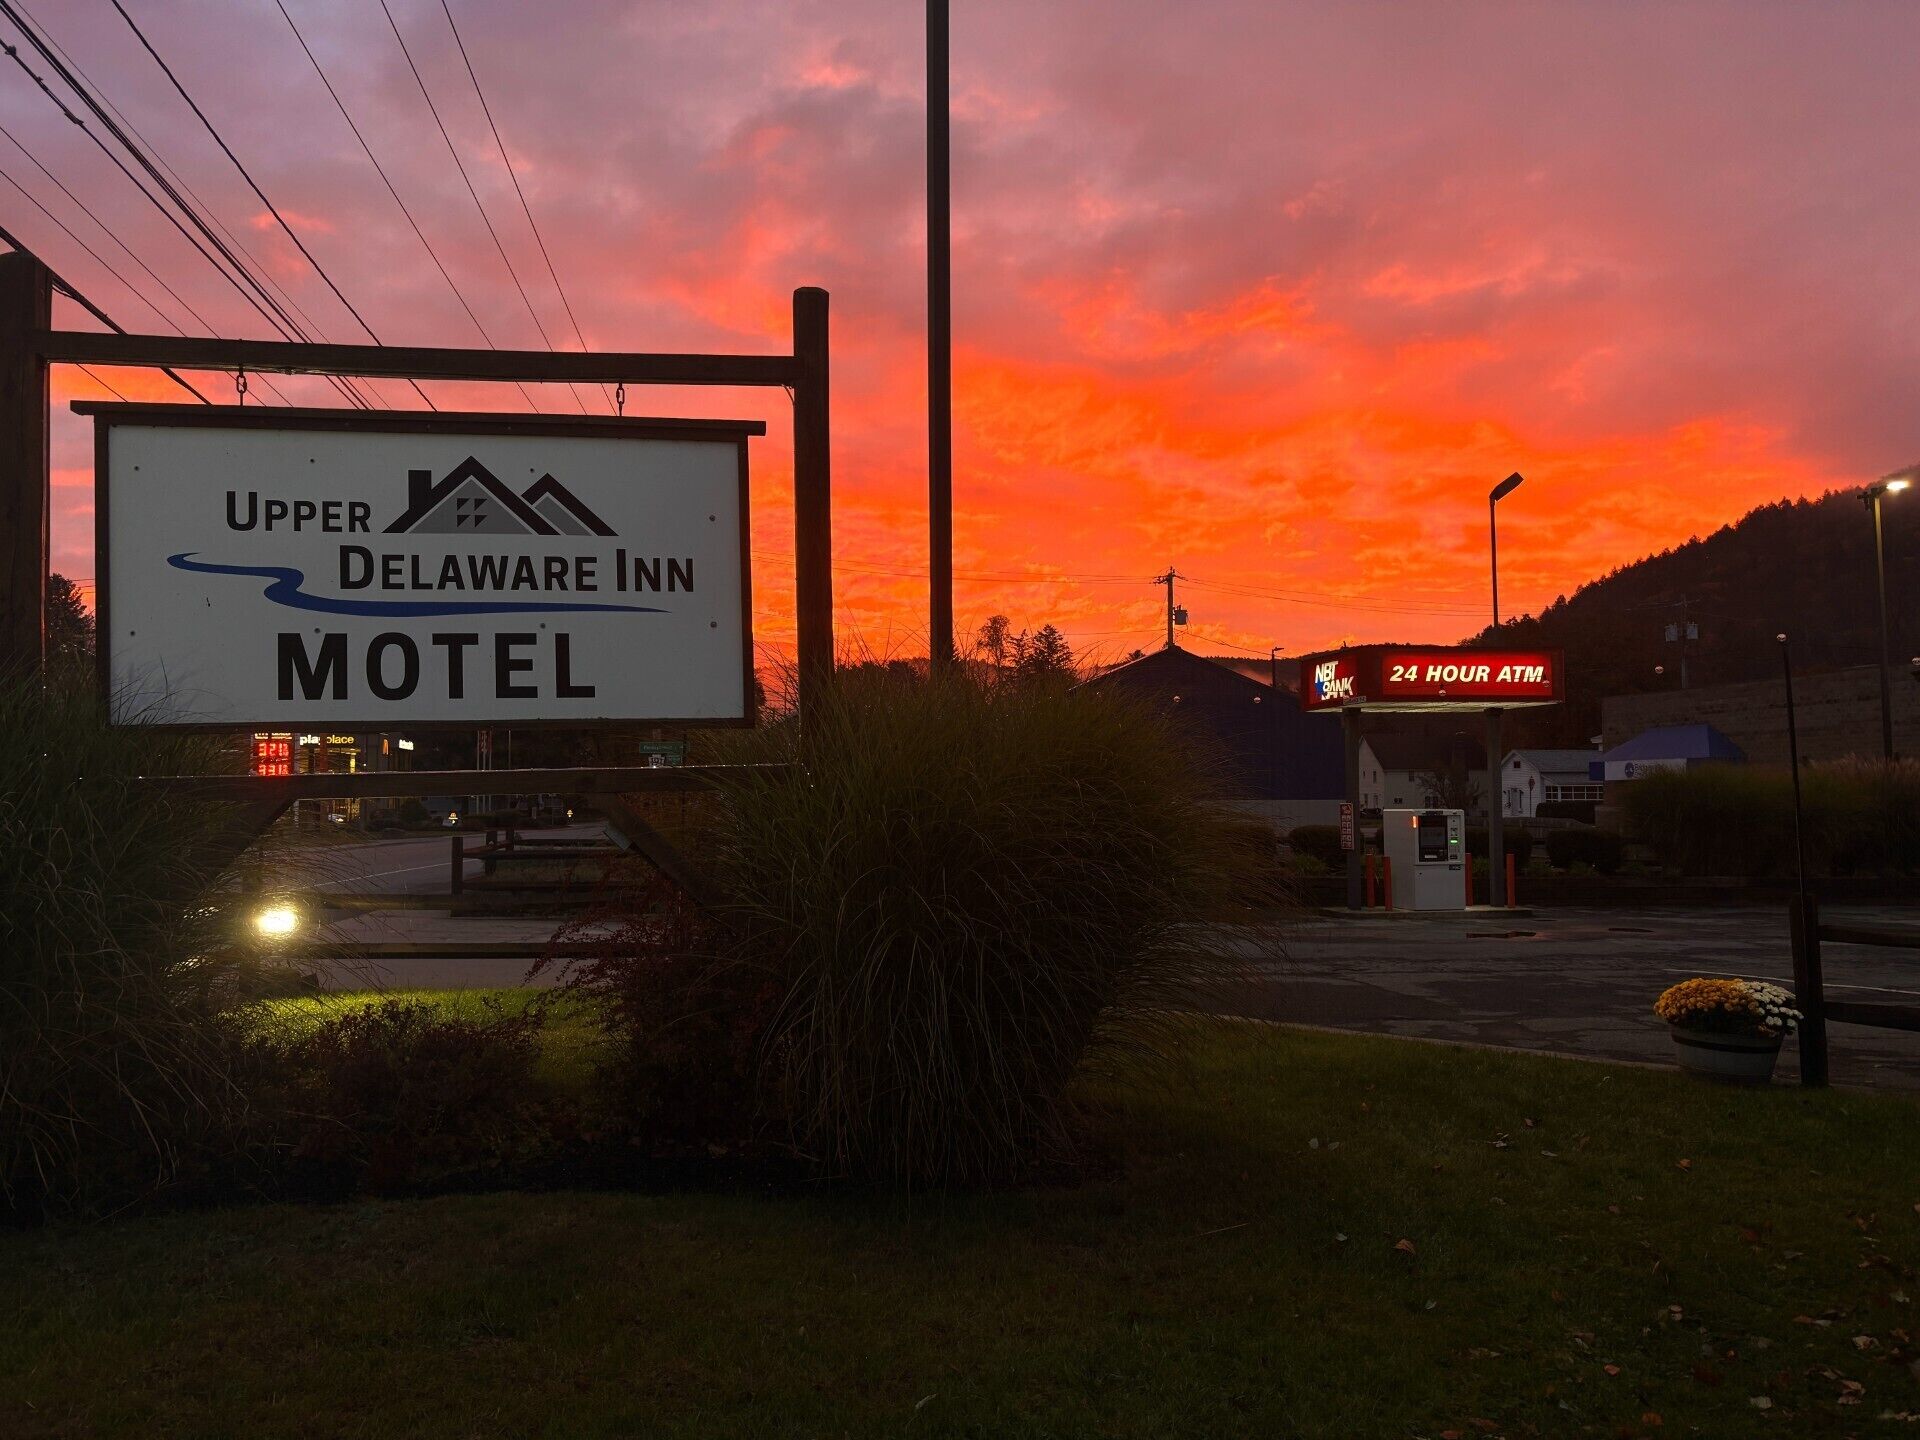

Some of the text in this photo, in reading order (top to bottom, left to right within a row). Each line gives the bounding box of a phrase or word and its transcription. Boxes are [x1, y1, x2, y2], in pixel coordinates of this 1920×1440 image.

[226, 491, 371, 532] UPPER
[339, 545, 694, 593] DELAWARE INN
[278, 632, 596, 701] MOTEL
[1314, 660, 1339, 684] NBT
[1389, 665, 1544, 682] 24 HOUR ATM
[1321, 676, 1354, 701] BANK
